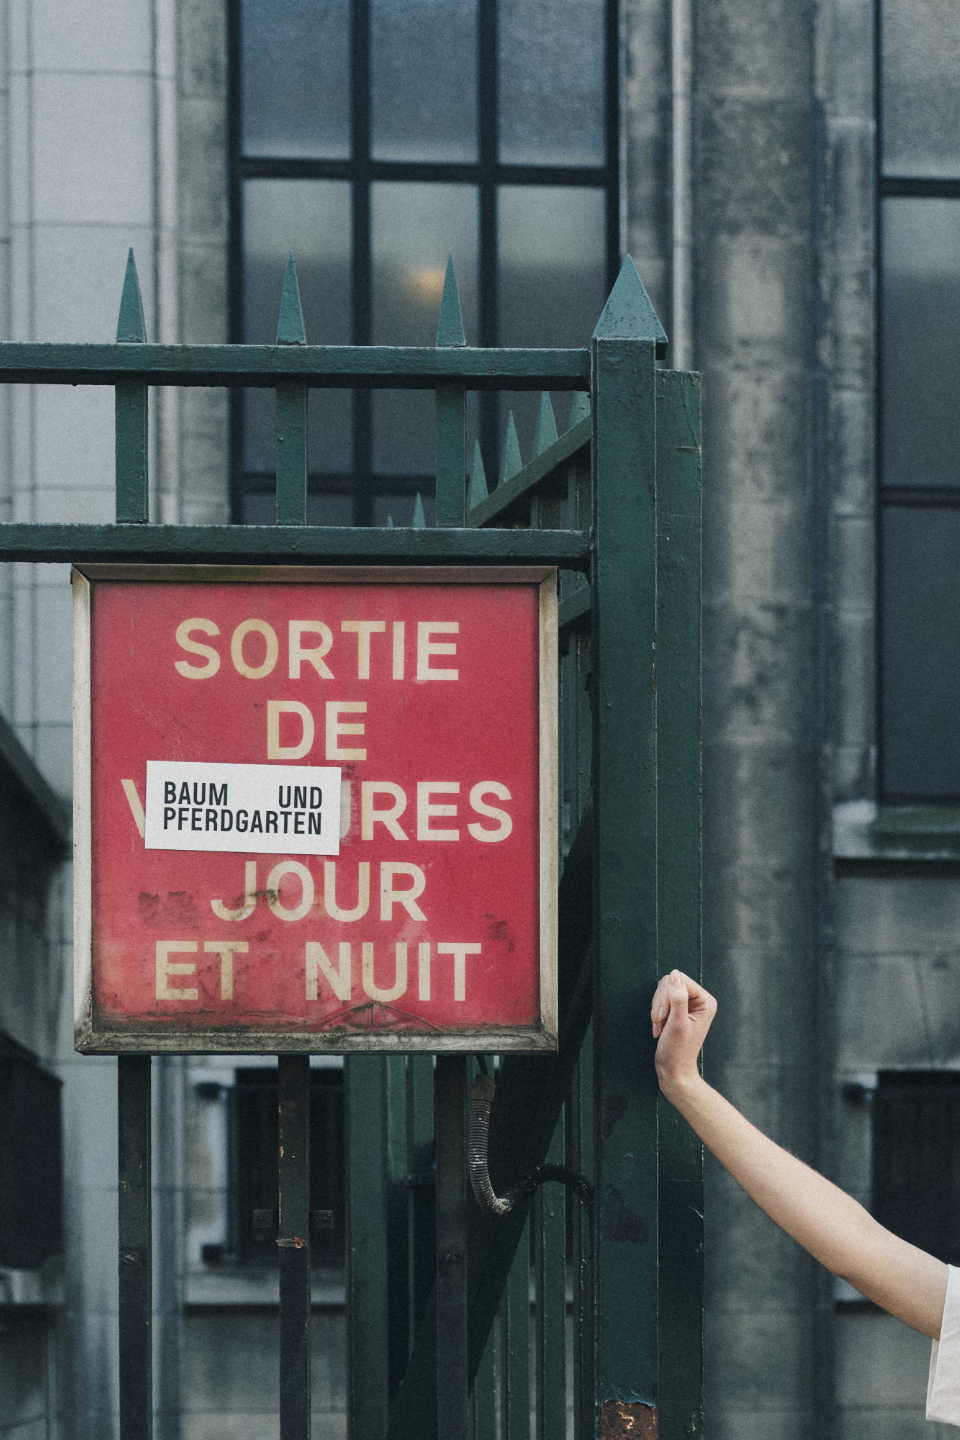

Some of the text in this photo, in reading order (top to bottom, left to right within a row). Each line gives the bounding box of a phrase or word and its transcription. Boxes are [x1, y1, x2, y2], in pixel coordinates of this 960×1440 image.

[174, 618, 459, 681] SORTIE
[267, 700, 367, 760] DE
[164, 807, 321, 834] PFERDGARTEN
[165, 782, 322, 809] BAUM UND
[211, 861, 427, 922] JOUR
[153, 940, 481, 1001] ET NUIT
